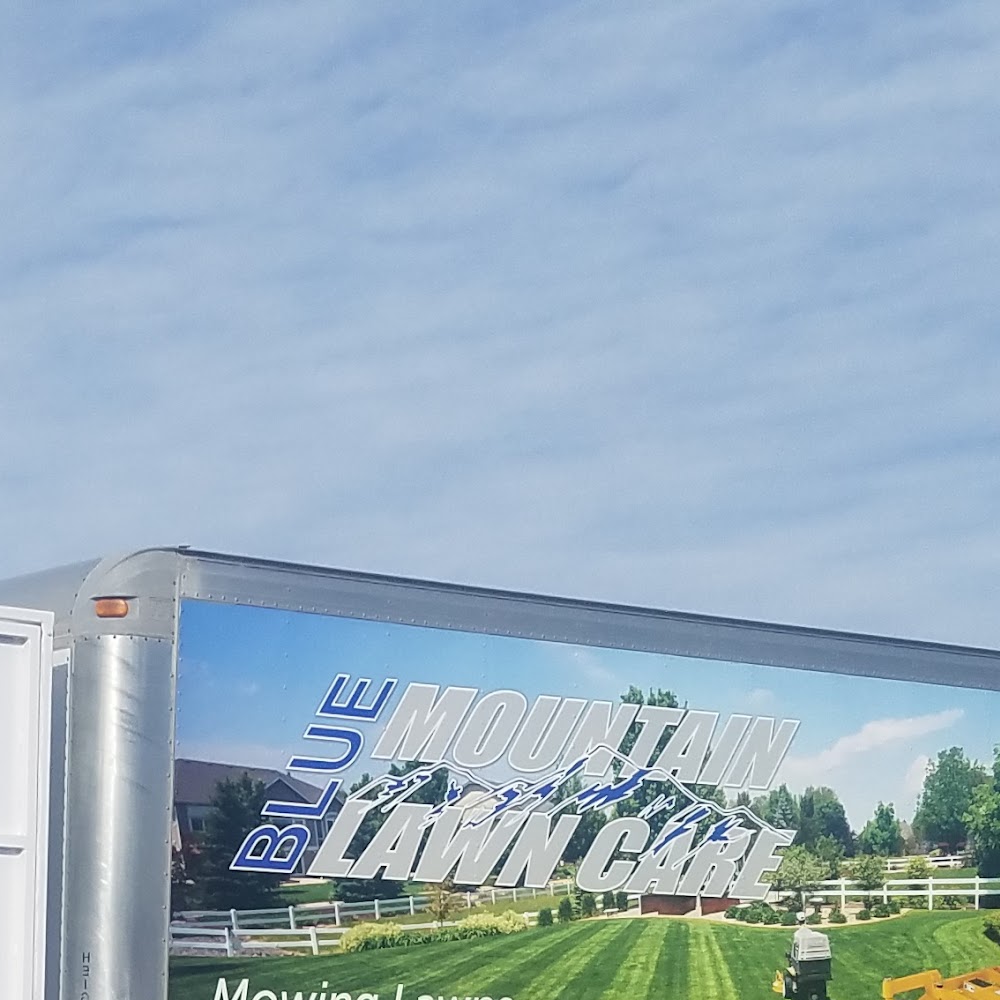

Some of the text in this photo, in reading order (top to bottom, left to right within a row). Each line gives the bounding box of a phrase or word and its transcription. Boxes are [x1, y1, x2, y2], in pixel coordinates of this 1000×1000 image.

[229, 673, 399, 874] BLUE
[370, 681, 801, 790] MOUNTAIN
[305, 798, 798, 901] LAWN CARE
